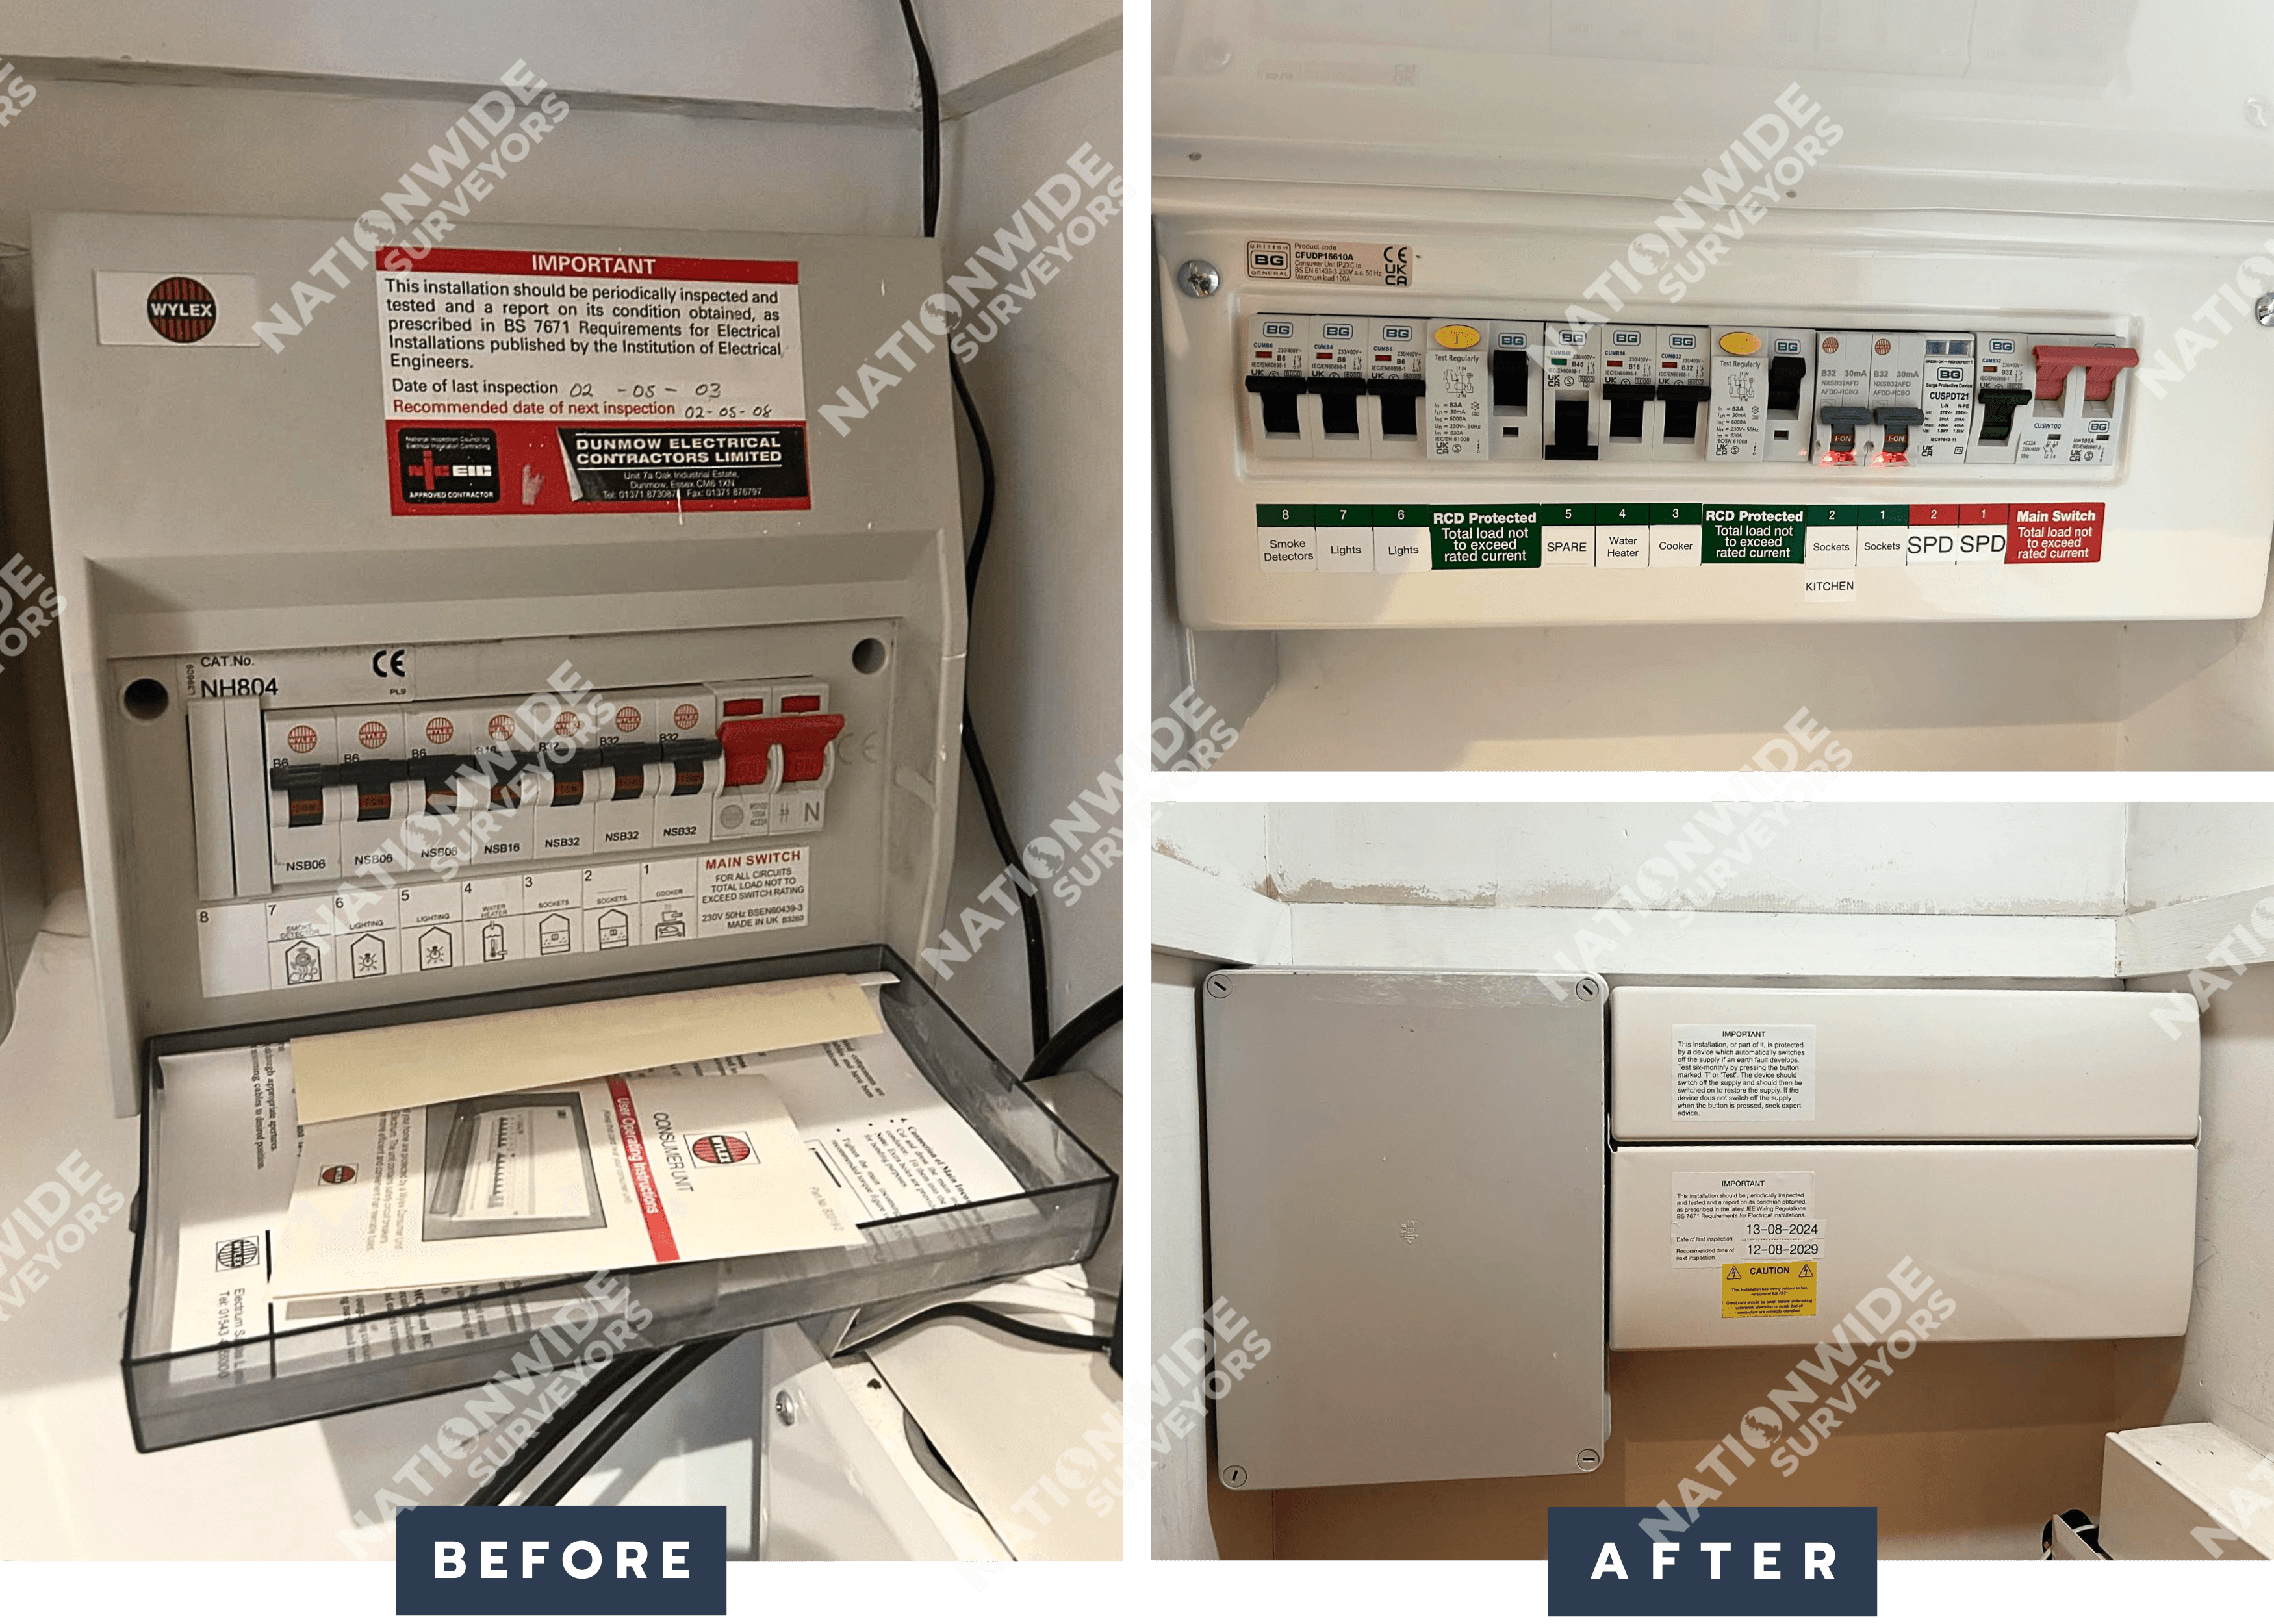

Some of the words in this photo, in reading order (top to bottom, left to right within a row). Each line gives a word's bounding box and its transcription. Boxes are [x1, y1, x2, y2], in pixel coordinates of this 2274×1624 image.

[1255, 255, 1283, 266] BG
[1295, 251, 1353, 260] CFUDP16610A
[533, 255, 656, 274] IMPORTANT
[385, 278, 419, 293] This
[424, 279, 509, 296] installation
[514, 283, 565, 298] should
[570, 285, 587, 298] be
[593, 286, 676, 303] periodically
[680, 287, 748, 304] inspected
[752, 291, 778, 303] and
[151, 303, 212, 316] WYLEX
[387, 299, 435, 312] tested
[446, 299, 474, 313] and
[485, 303, 492, 314] a
[503, 303, 549, 317] report
[558, 305, 577, 316] on
[587, 303, 604, 316] its
[613, 304, 680, 318] condition
[689, 306, 755, 322] obtained,
[764, 311, 779, 321] as
[1993, 342, 2012, 350] BG
[1449, 355, 1479, 363] Regularly
[392, 378, 427, 392] Date
[433, 379, 447, 392] of
[452, 379, 478, 393] last
[483, 380, 557, 396] inspection
[1930, 392, 1969, 400] CUSPDT21
[394, 400, 508, 414] Recommended
[513, 401, 544, 414] date
[549, 401, 563, 414] of
[568, 403, 599, 414] next
[604, 403, 675, 417] inspection
[576, 439, 661, 450] DUNMOW
[670, 438, 780, 448] ELECTRICAL
[577, 452, 709, 464] CONTRACTORS
[715, 451, 782, 462] LIMITED
[1283, 509, 1289, 520] 8
[1340, 510, 1347, 520] 7
[1398, 510, 1404, 520] 6
[1434, 513, 1464, 524] RCD
[1469, 512, 1536, 524] Protected
[1565, 509, 1572, 518] 5
[1619, 509, 1626, 518] 4
[1672, 509, 1678, 518] 3
[1706, 511, 1735, 521] RCD
[1739, 511, 1803, 522] Protected
[1829, 511, 1835, 520] 2
[1880, 510, 1885, 519] 1
[1931, 509, 1937, 519] 2
[1982, 509, 1985, 518] 1
[2017, 511, 2048, 522] Main
[2052, 510, 2095, 522] Switch
[1442, 527, 1472, 539] Total
[1477, 527, 1503, 539] load
[1509, 527, 1528, 538] not
[1270, 539, 1305, 548] Smoke
[1453, 540, 1466, 550] to
[1471, 539, 1516, 550] exceed
[1548, 542, 1587, 552] SPARE
[1908, 536, 1953, 553] SPD
[1960, 535, 2006, 553] SPD
[1331, 546, 1361, 556] Lights
[1388, 546, 1418, 556] Lights
[1445, 551, 1474, 562] rated
[1481, 550, 1526, 561] current
[1264, 553, 1313, 561] Detectors
[1806, 581, 1853, 590] KITCHEN
[201, 655, 255, 668] CAT.No.
[201, 678, 279, 698] NH804
[606, 831, 639, 842] NSB32
[663, 826, 696, 836] NSB32
[545, 837, 580, 848] NSB32
[421, 847, 457, 858] NSB06
[485, 843, 520, 854] NSB16
[287, 859, 325, 871] NSB06
[355, 854, 392, 865] NSB06
[706, 857, 741, 869] MAIN
[747, 850, 800, 866] SWITCH
[645, 865, 648, 874] 1
[585, 870, 592, 881] 2
[526, 877, 532, 887] 3
[465, 883, 472, 893] 4
[402, 890, 409, 901] 5
[336, 898, 343, 908] 6
[268, 904, 276, 915] 7
[200, 911, 209, 923] 8
[617, 1097, 630, 1115] User
[622, 1118, 644, 1161] Operating
[653, 1113, 685, 1169] CONSUMER
[671, 1171, 693, 1191] UNIT
[711, 1137, 732, 1163] WYLEX
[630, 1162, 659, 1213] Instructions
[1747, 1224, 1818, 1235] 13-08-2024
[1748, 1244, 1819, 1254] 12-08-2029
[1749, 1266, 1790, 1275] CAUTION
